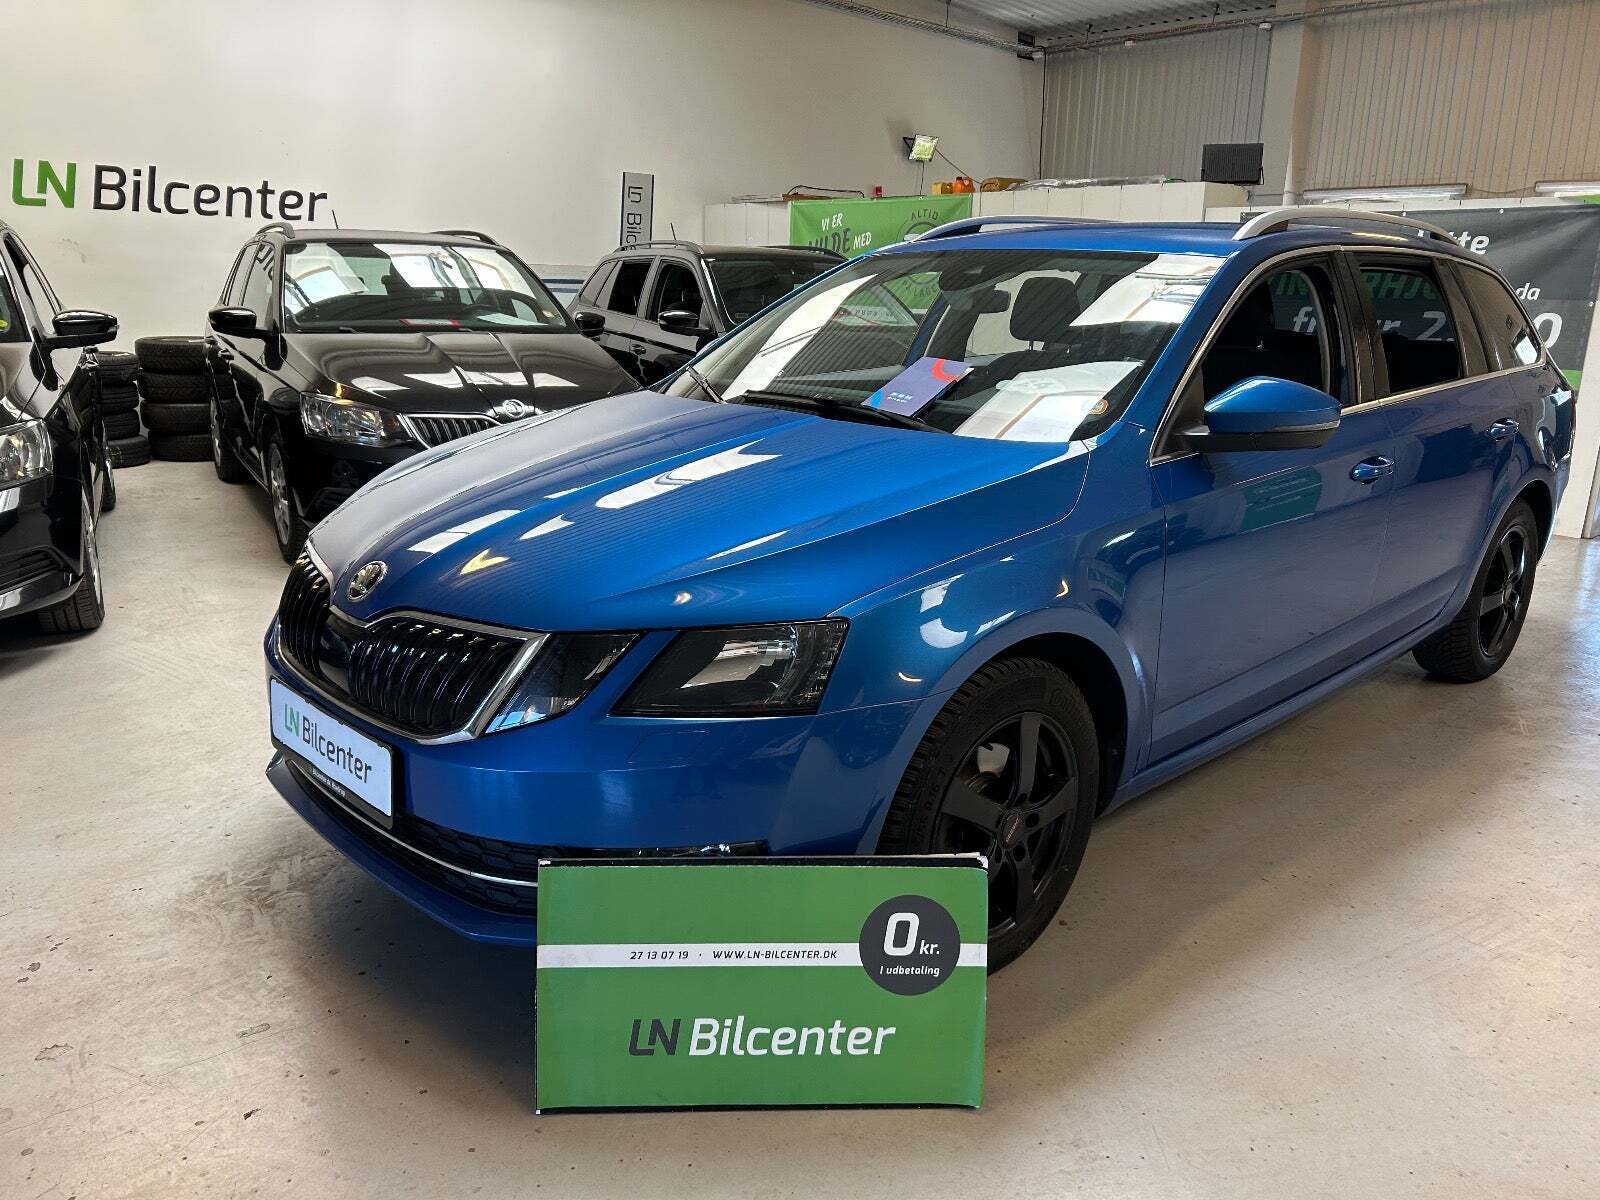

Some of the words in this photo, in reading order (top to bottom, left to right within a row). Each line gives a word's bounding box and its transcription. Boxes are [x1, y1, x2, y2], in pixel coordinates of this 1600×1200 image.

[12, 159, 77, 209] LN
[92, 164, 329, 222] Bilcenter
[821, 216, 830, 231] VI
[832, 213, 844, 229] ER
[853, 232, 872, 250] MED
[285, 704, 299, 736] LN
[303, 715, 372, 783] Bilcenter
[883, 912, 920, 956] 0
[920, 938, 940, 956] kr.
[630, 950, 644, 960] 27
[647, 950, 658, 960] 13
[661, 950, 675, 960] 07
[678, 950, 689, 960] 19
[712, 950, 838, 960] WWW.LN-BILCENTER.DK
[886, 965, 941, 979] udbetaling
[628, 1018, 682, 1057] LN
[688, 1015, 897, 1057] Bilcenter
